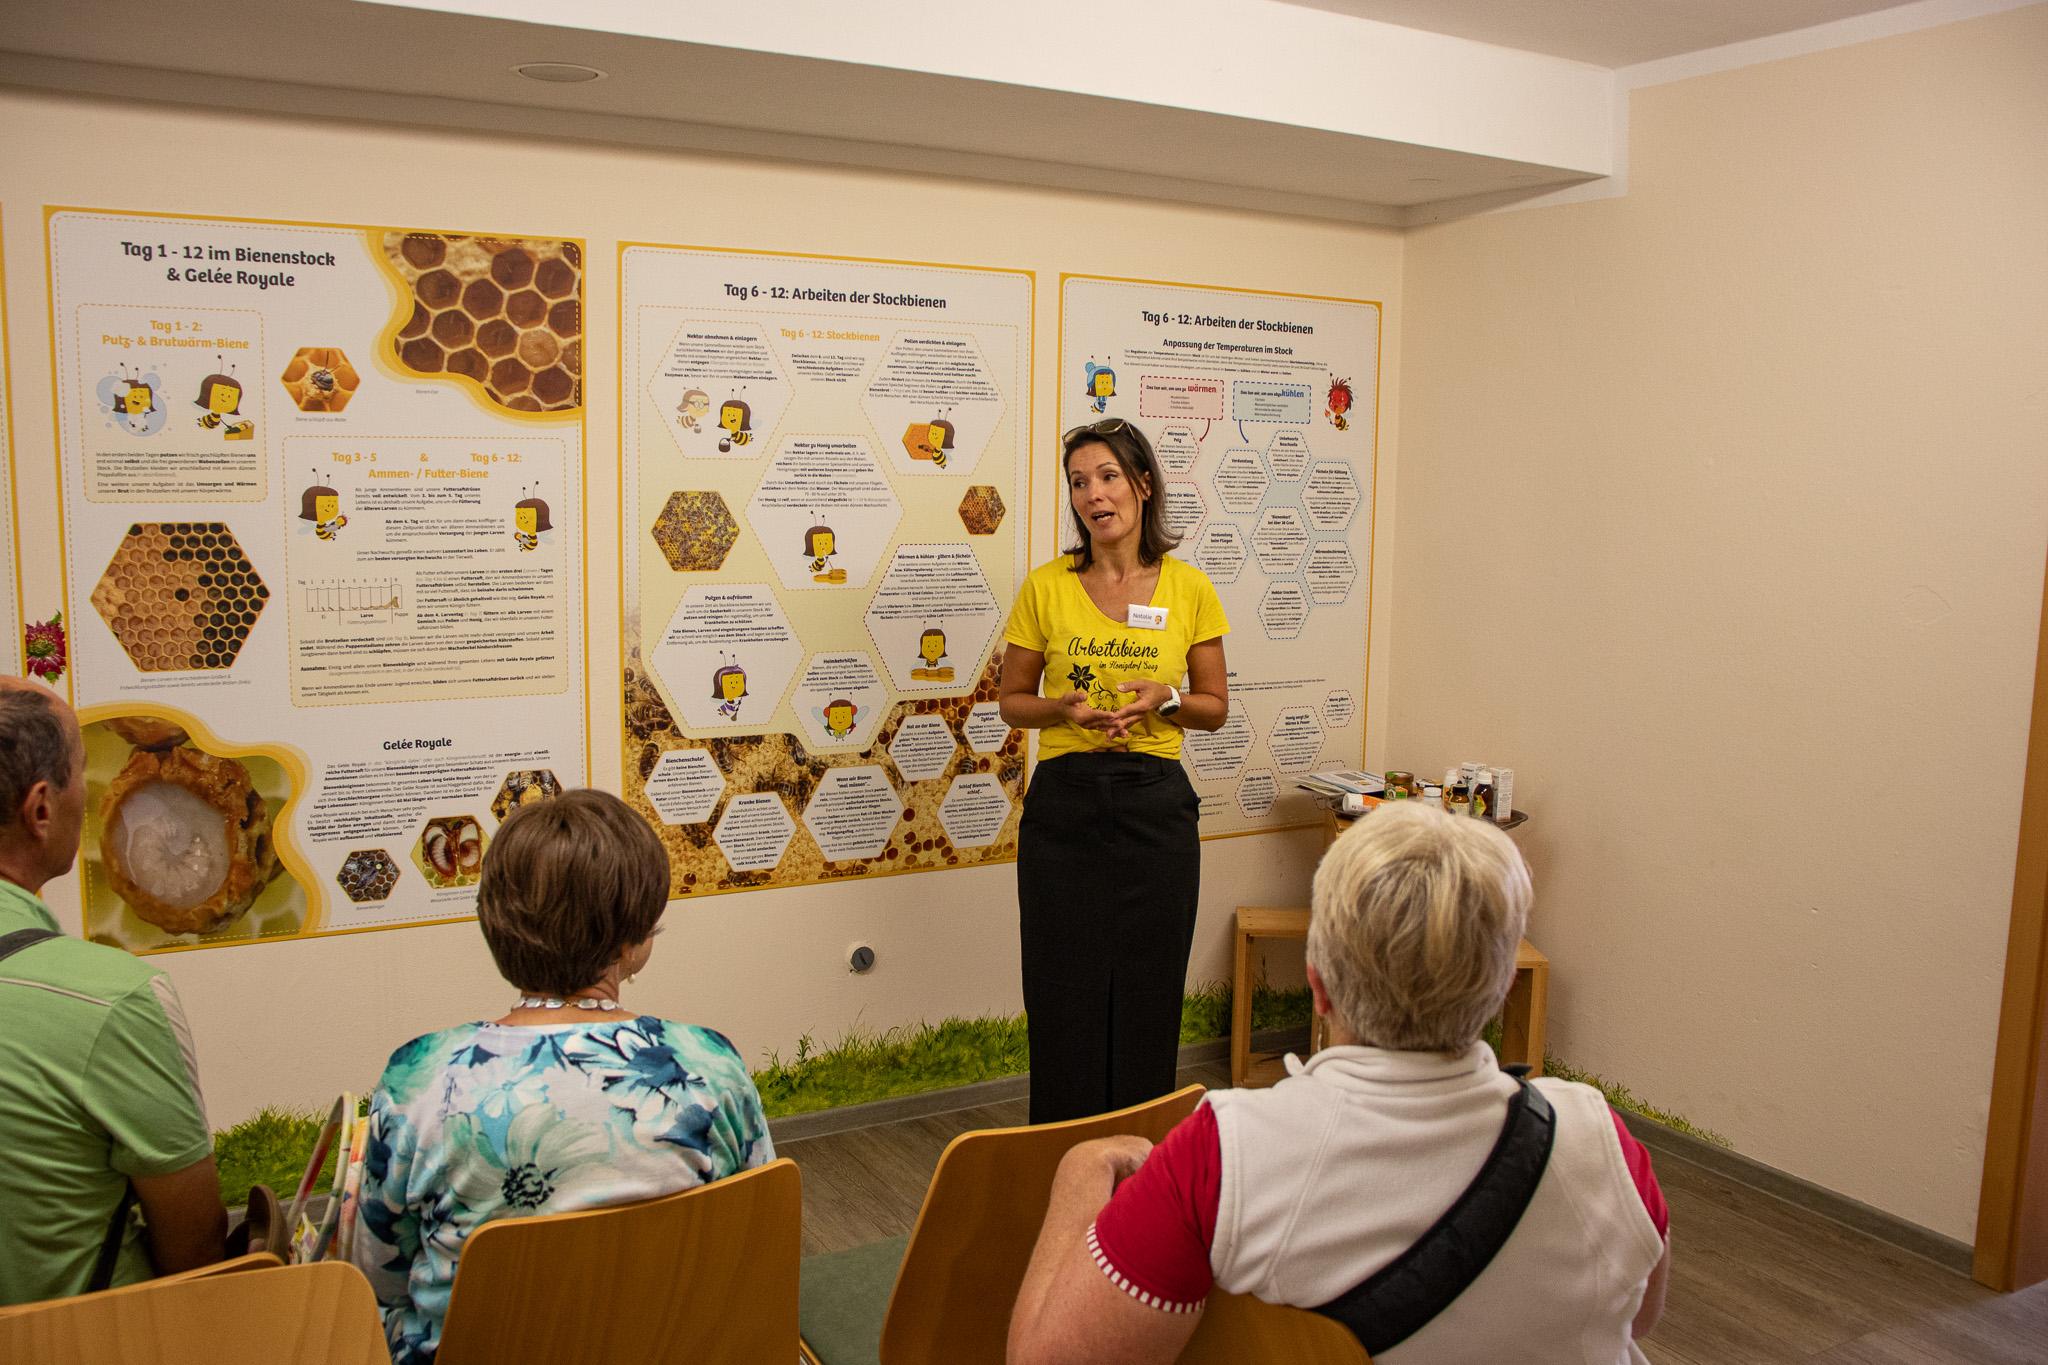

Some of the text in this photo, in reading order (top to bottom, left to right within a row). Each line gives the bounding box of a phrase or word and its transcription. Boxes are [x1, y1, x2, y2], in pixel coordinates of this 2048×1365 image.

[121, 241, 152, 261] Tag
[158, 244, 167, 258] 1
[183, 246, 204, 260] 12
[208, 247, 230, 261] im
[236, 248, 336, 266] Bienenstock
[166, 267, 295, 290] & Gelée Royale
[724, 283, 748, 301] Tag
[751, 285, 759, 299] 6
[770, 286, 789, 300] 12:
[792, 287, 846, 303] Arbeiten
[850, 290, 870, 304] der
[873, 292, 946, 309] Stockbienen
[150, 320, 171, 334] Tag
[175, 321, 182, 332] 1
[192, 322, 202, 332] 2:
[1142, 311, 1160, 326] Tag
[1162, 312, 1169, 324] 6
[1178, 314, 1192, 326] 12:
[1194, 316, 1236, 330] Arbeiten
[1238, 318, 1254, 330] der
[1256, 320, 1314, 336] Stockbienen
[102, 334, 249, 350] Putz- & Brutwärm-Biene
[780, 328, 796, 341] Tag
[798, 330, 804, 339] 6
[812, 330, 824, 340] 12:
[826, 330, 880, 342] Stockbienen
[1162, 338, 1292, 356] Anpassung der Temperaturen im Stock
[1188, 384, 1216, 393] wärmen
[332, 452, 352, 464] Tag
[355, 453, 361, 462] 3
[370, 453, 376, 462] 5
[420, 453, 429, 462] &
[470, 453, 490, 464] Tag
[492, 454, 498, 462] 6
[508, 454, 522, 462] 12:
[368, 468, 488, 480] Ammen- / Futter-Biene
[1068, 636, 1160, 658] Arbeitsbiene
[1109, 660, 1142, 672] Honigdorf
[383, 737, 452, 751] Gelée Royale
